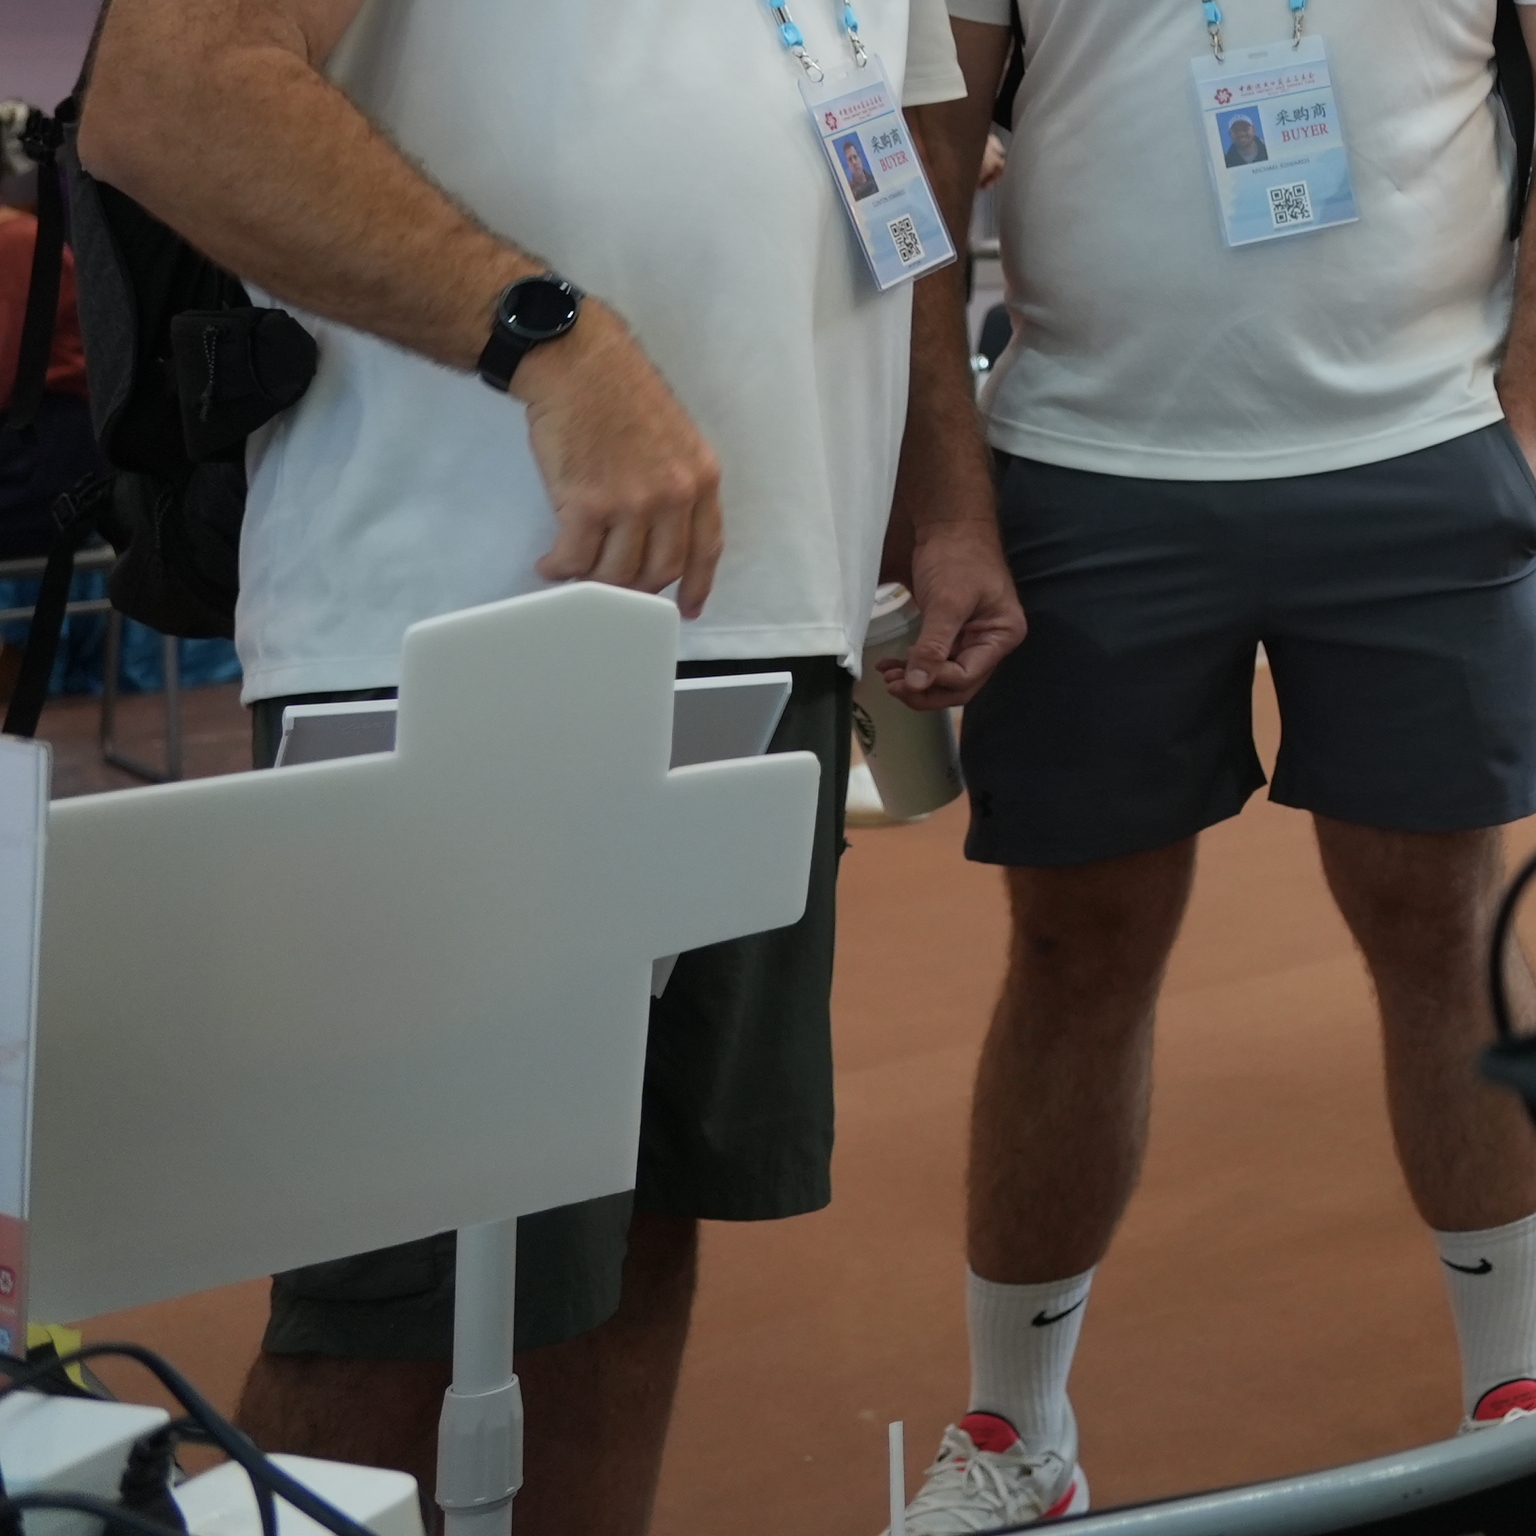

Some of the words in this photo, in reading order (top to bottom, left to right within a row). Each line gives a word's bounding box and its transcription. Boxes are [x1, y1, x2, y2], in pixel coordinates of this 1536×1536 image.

[1276, 102, 1327, 126] 采购商
[1281, 123, 1329, 143] BUYER
[879, 150, 908, 172] BUYER
